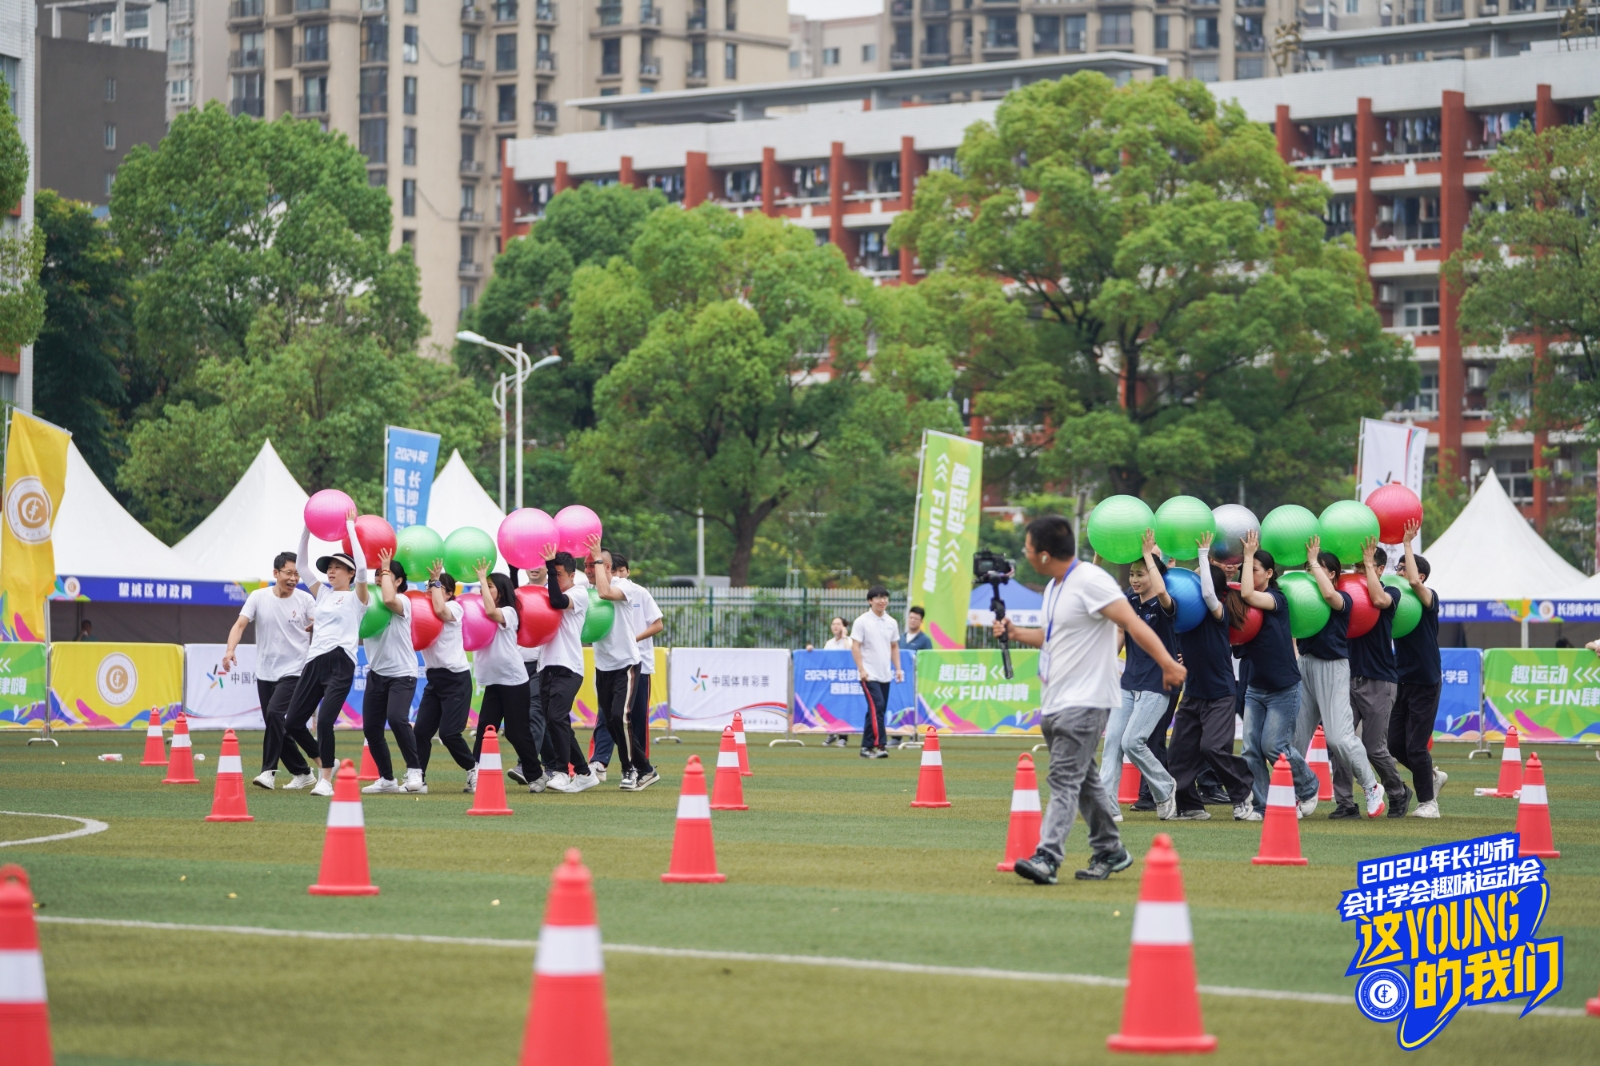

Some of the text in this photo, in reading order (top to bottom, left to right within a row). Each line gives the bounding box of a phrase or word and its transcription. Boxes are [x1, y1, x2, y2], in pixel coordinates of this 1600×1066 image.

[394, 446, 429, 465] 2024年
[945, 462, 971, 535] 趣运动
[118, 582, 193, 600] 望城区财政局
[712, 675, 770, 687] 中国体育彩票
[804, 669, 860, 681] 2024年长沙
[938, 664, 987, 682] 趣运动
[1510, 665, 1569, 685] 趣运动
[958, 683, 1029, 701] FUN肆嗨
